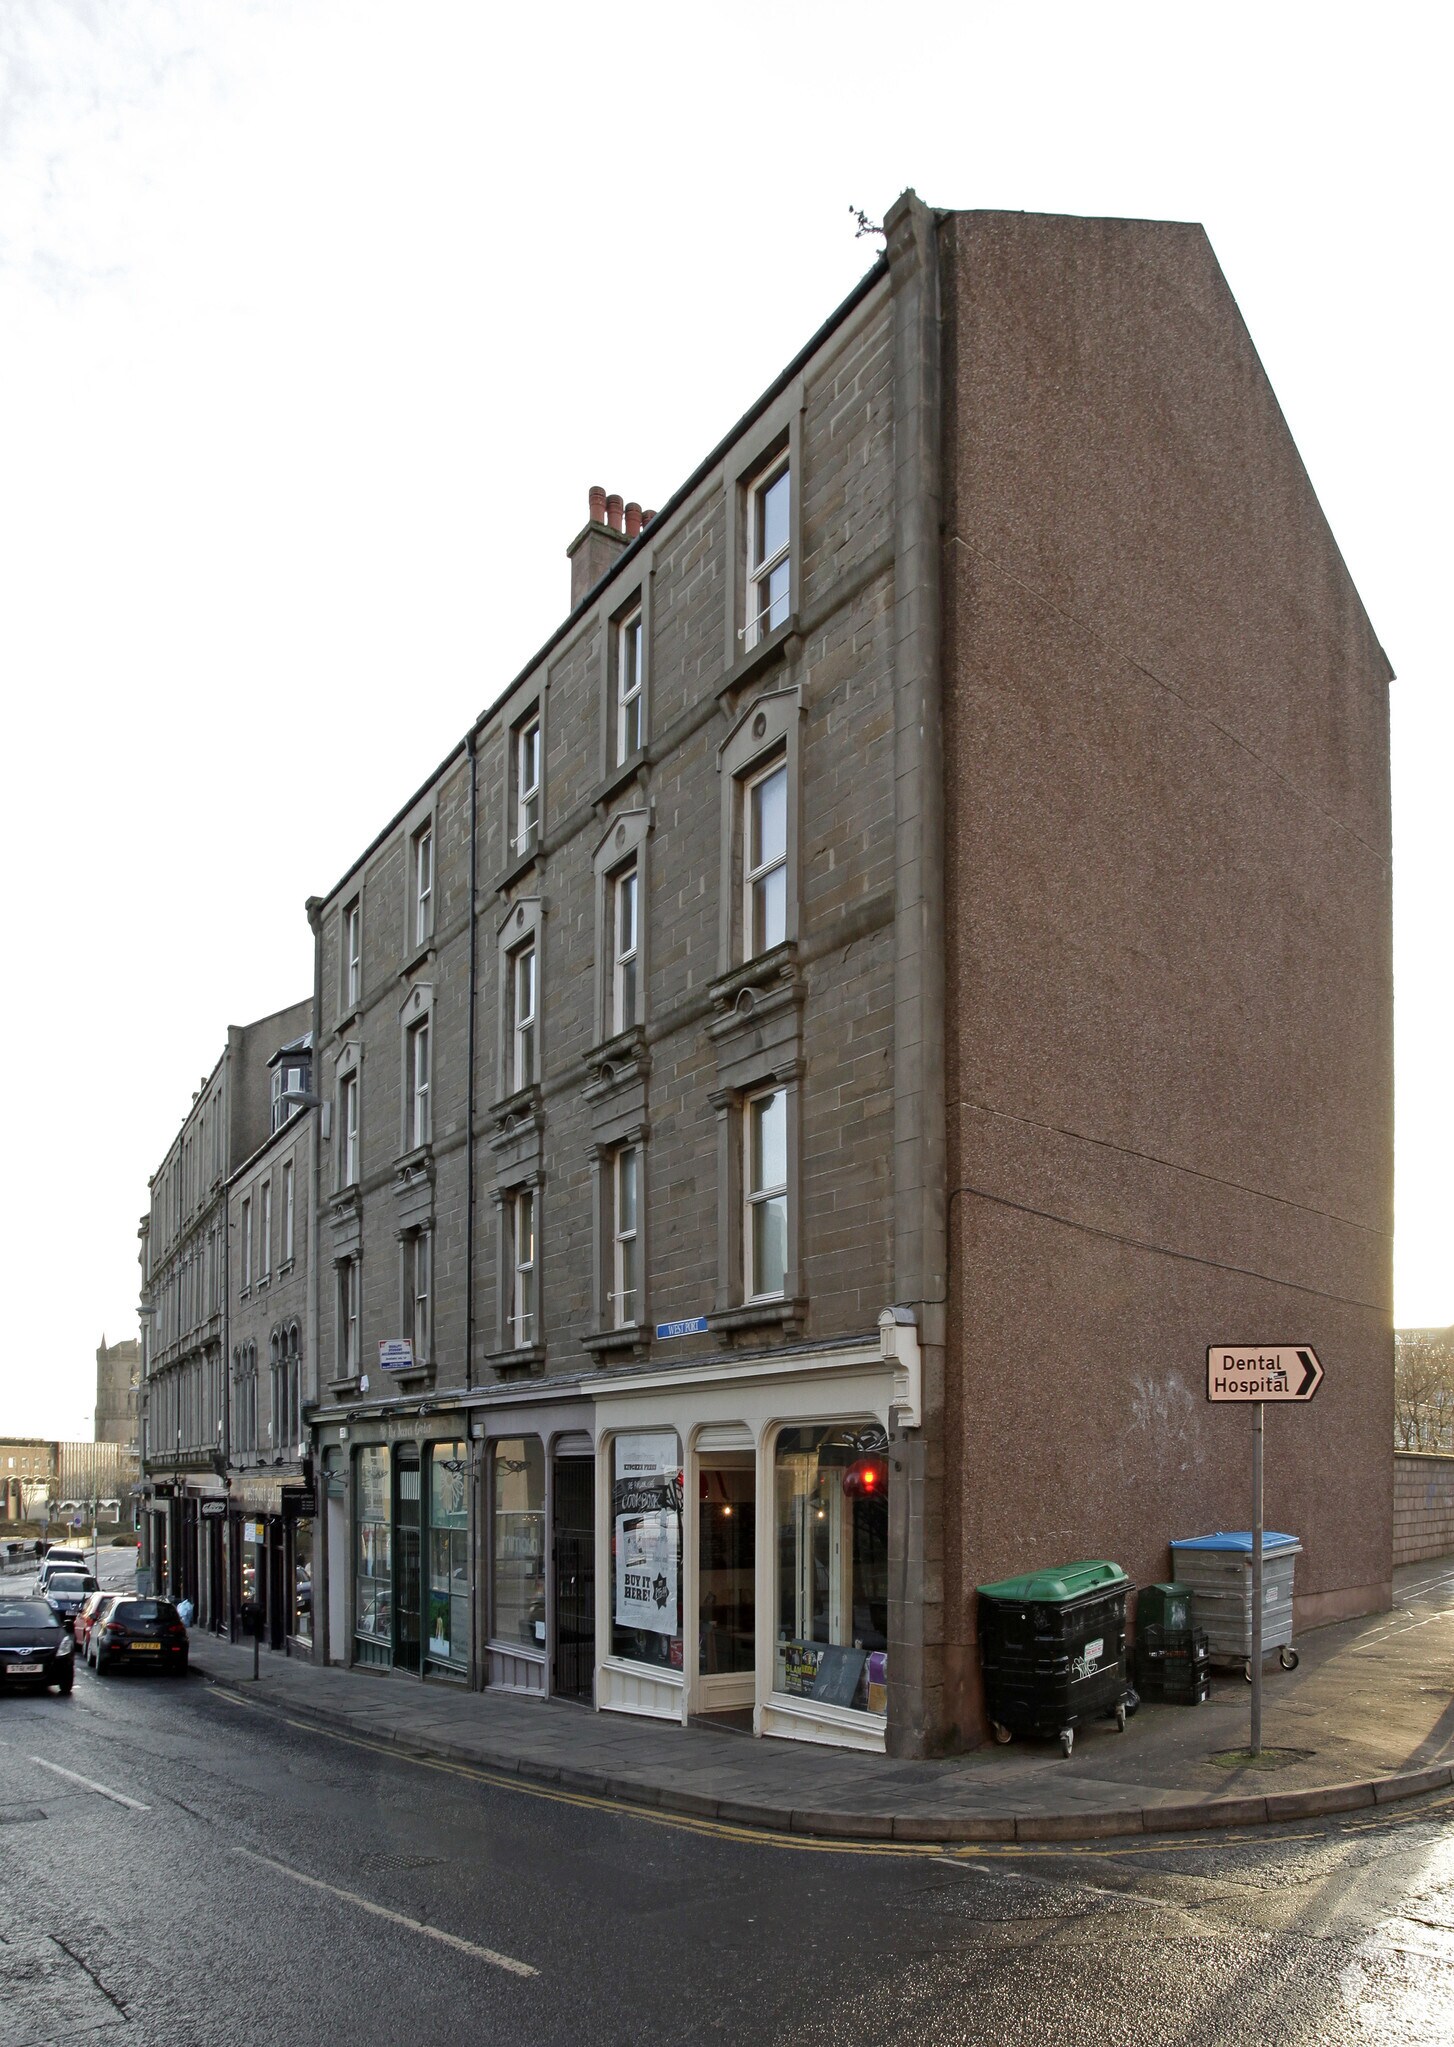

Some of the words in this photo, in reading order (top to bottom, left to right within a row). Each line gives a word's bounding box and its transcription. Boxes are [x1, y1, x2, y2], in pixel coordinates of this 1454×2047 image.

[668, 1323, 684, 1335] WEST
[685, 1320, 699, 1332] PORT
[1223, 1355, 1281, 1370] Dental
[1215, 1376, 1289, 1394] Hospital
[625, 1574, 641, 1587] BUY
[642, 1576, 650, 1588] IT
[624, 1586, 650, 1602] HERE!
